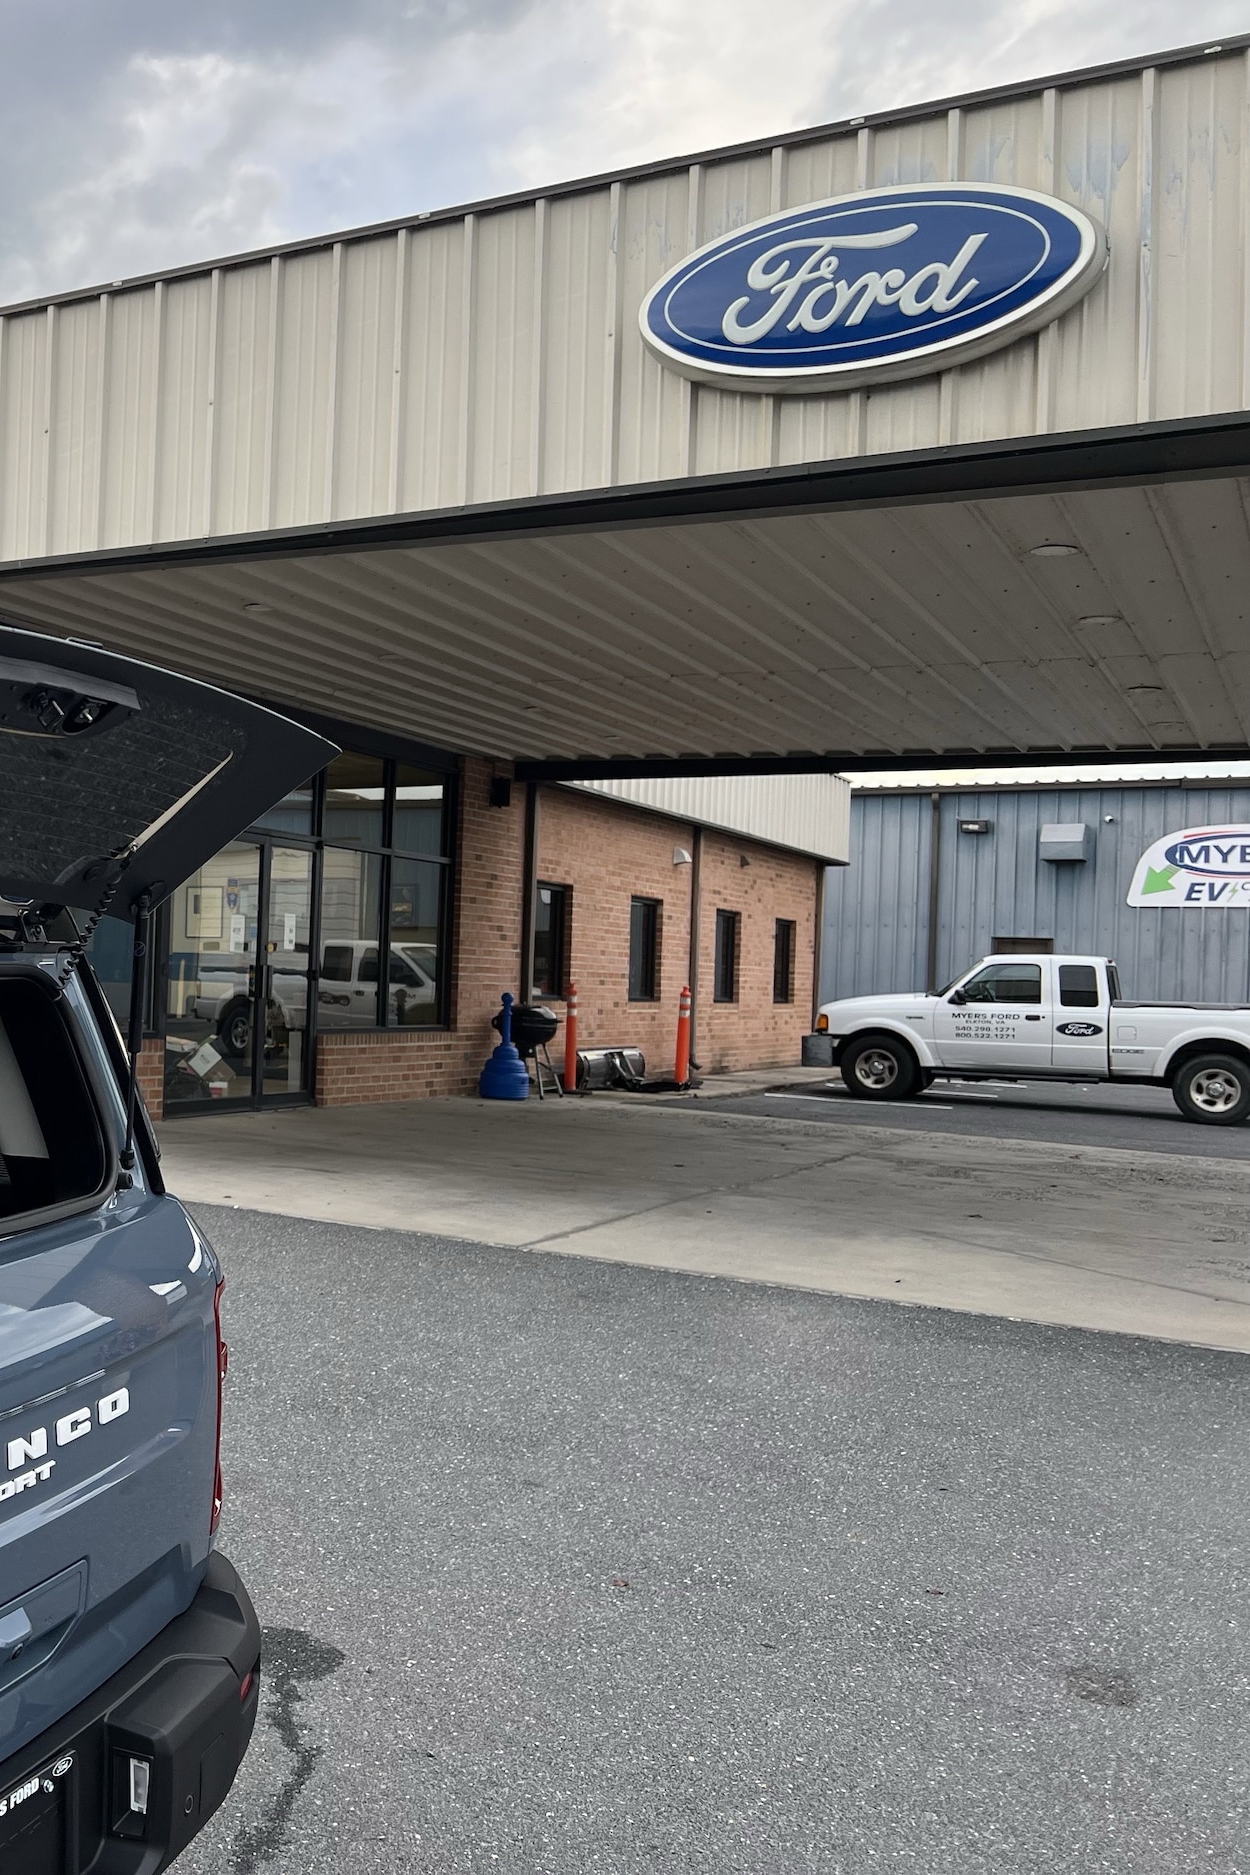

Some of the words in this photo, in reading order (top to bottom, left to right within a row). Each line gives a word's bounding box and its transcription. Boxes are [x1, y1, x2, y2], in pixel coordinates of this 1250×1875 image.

[721, 223, 989, 345] Ford
[1184, 882, 1230, 902] EV
[1064, 1023, 1095, 1035] Ford
[9, 1777, 40, 1810] FORD
